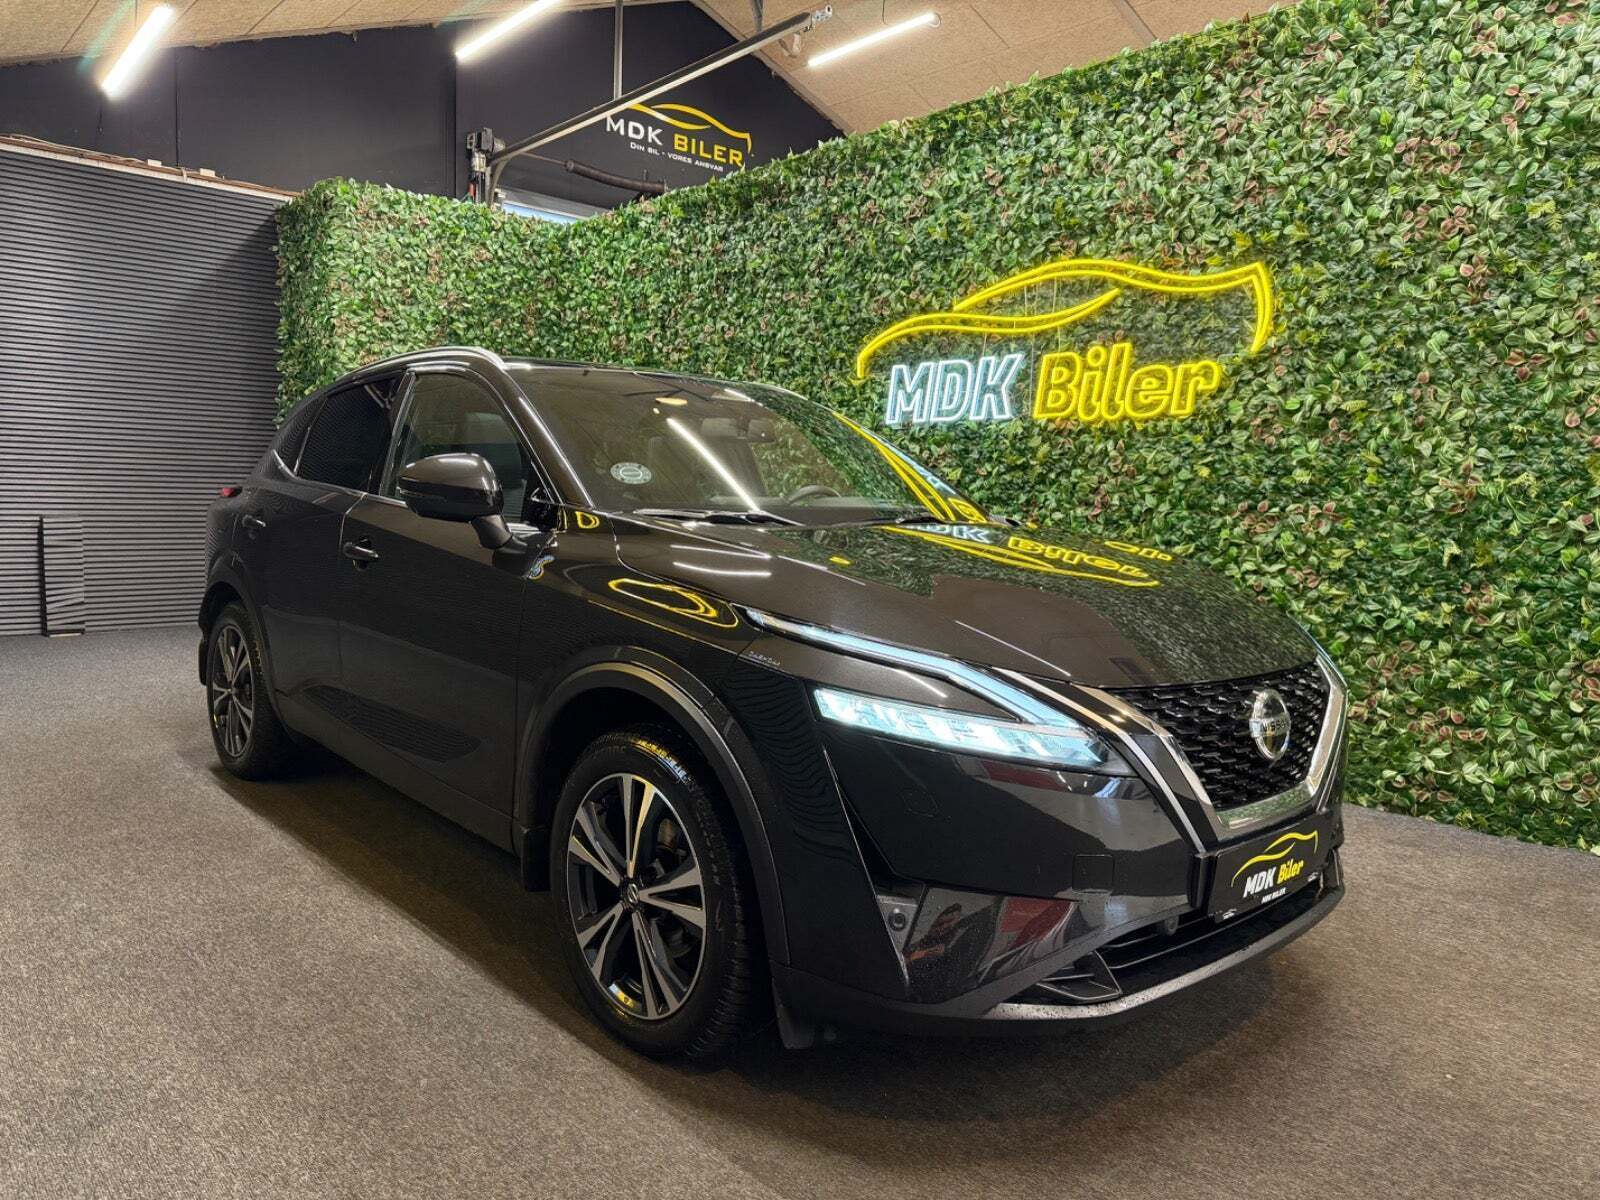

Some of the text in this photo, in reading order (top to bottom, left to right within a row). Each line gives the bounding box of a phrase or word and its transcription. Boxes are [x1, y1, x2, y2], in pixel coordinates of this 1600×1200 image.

[606, 117, 744, 167] MDK BILER
[886, 342, 1221, 425] MDK Biler
[1242, 858, 1304, 898] MDK Biler
